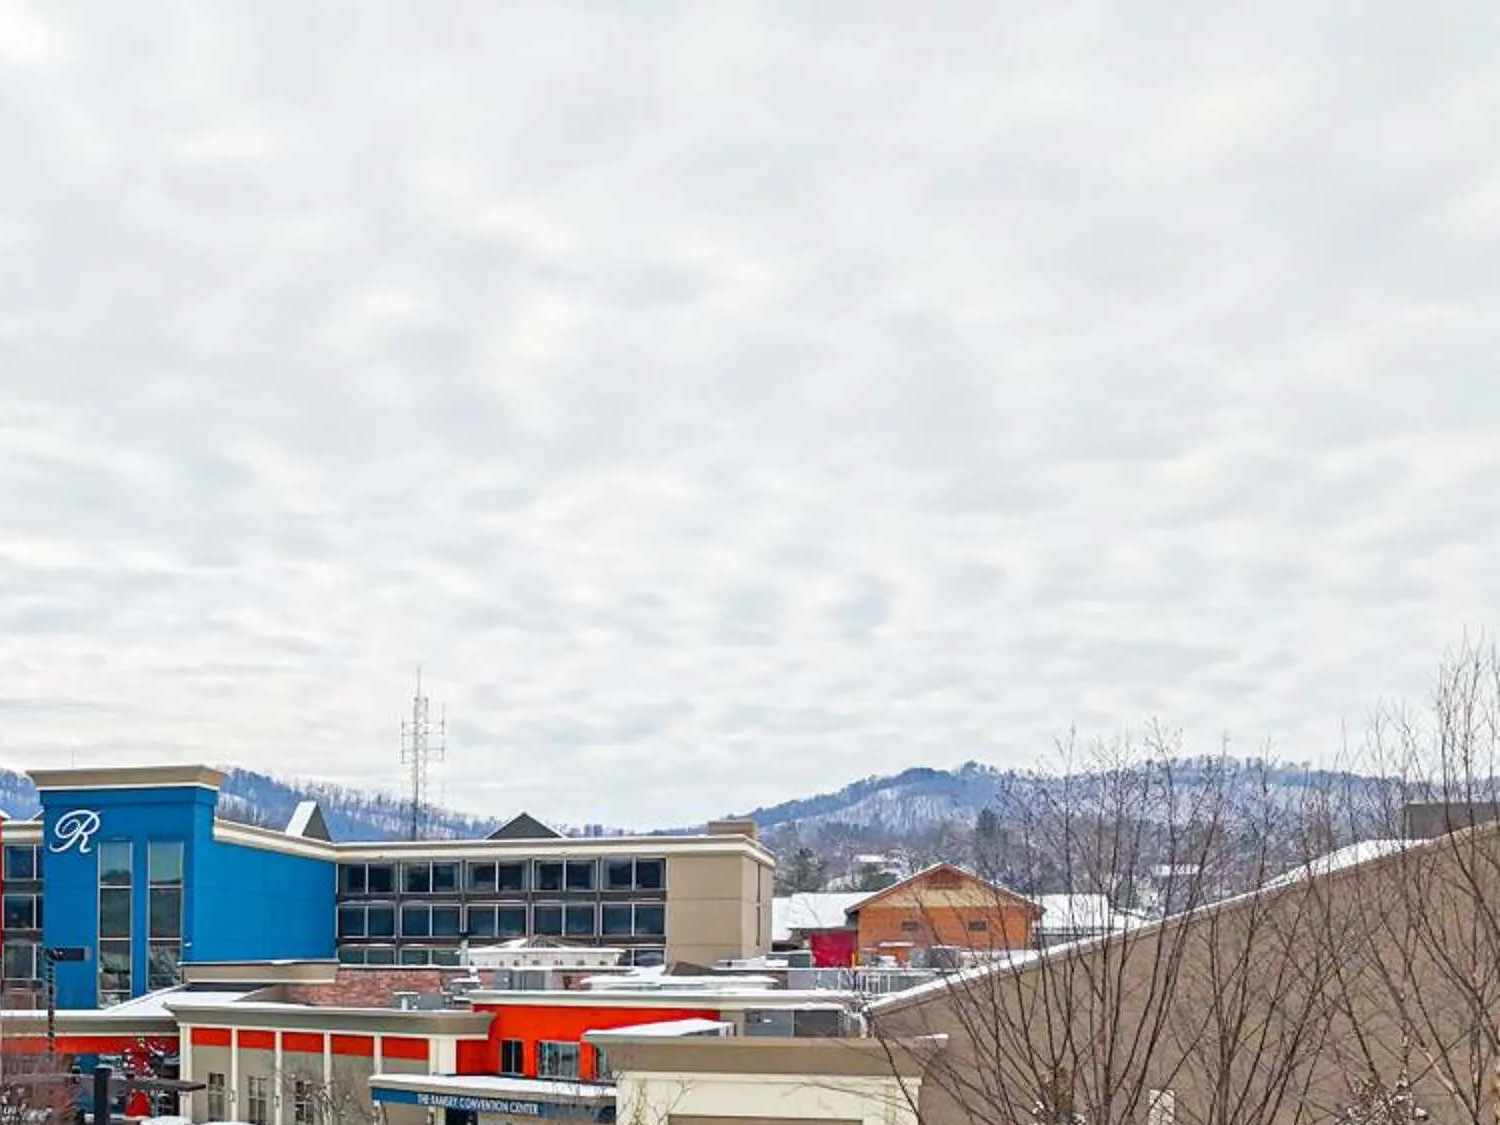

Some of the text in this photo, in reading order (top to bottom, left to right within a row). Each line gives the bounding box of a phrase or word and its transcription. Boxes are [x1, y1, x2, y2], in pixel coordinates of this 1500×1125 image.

[50, 809, 101, 854] R
[417, 1093, 429, 1106] THE
[459, 1097, 508, 1112] CONVENTION
[509, 1102, 539, 1115] CENTER
